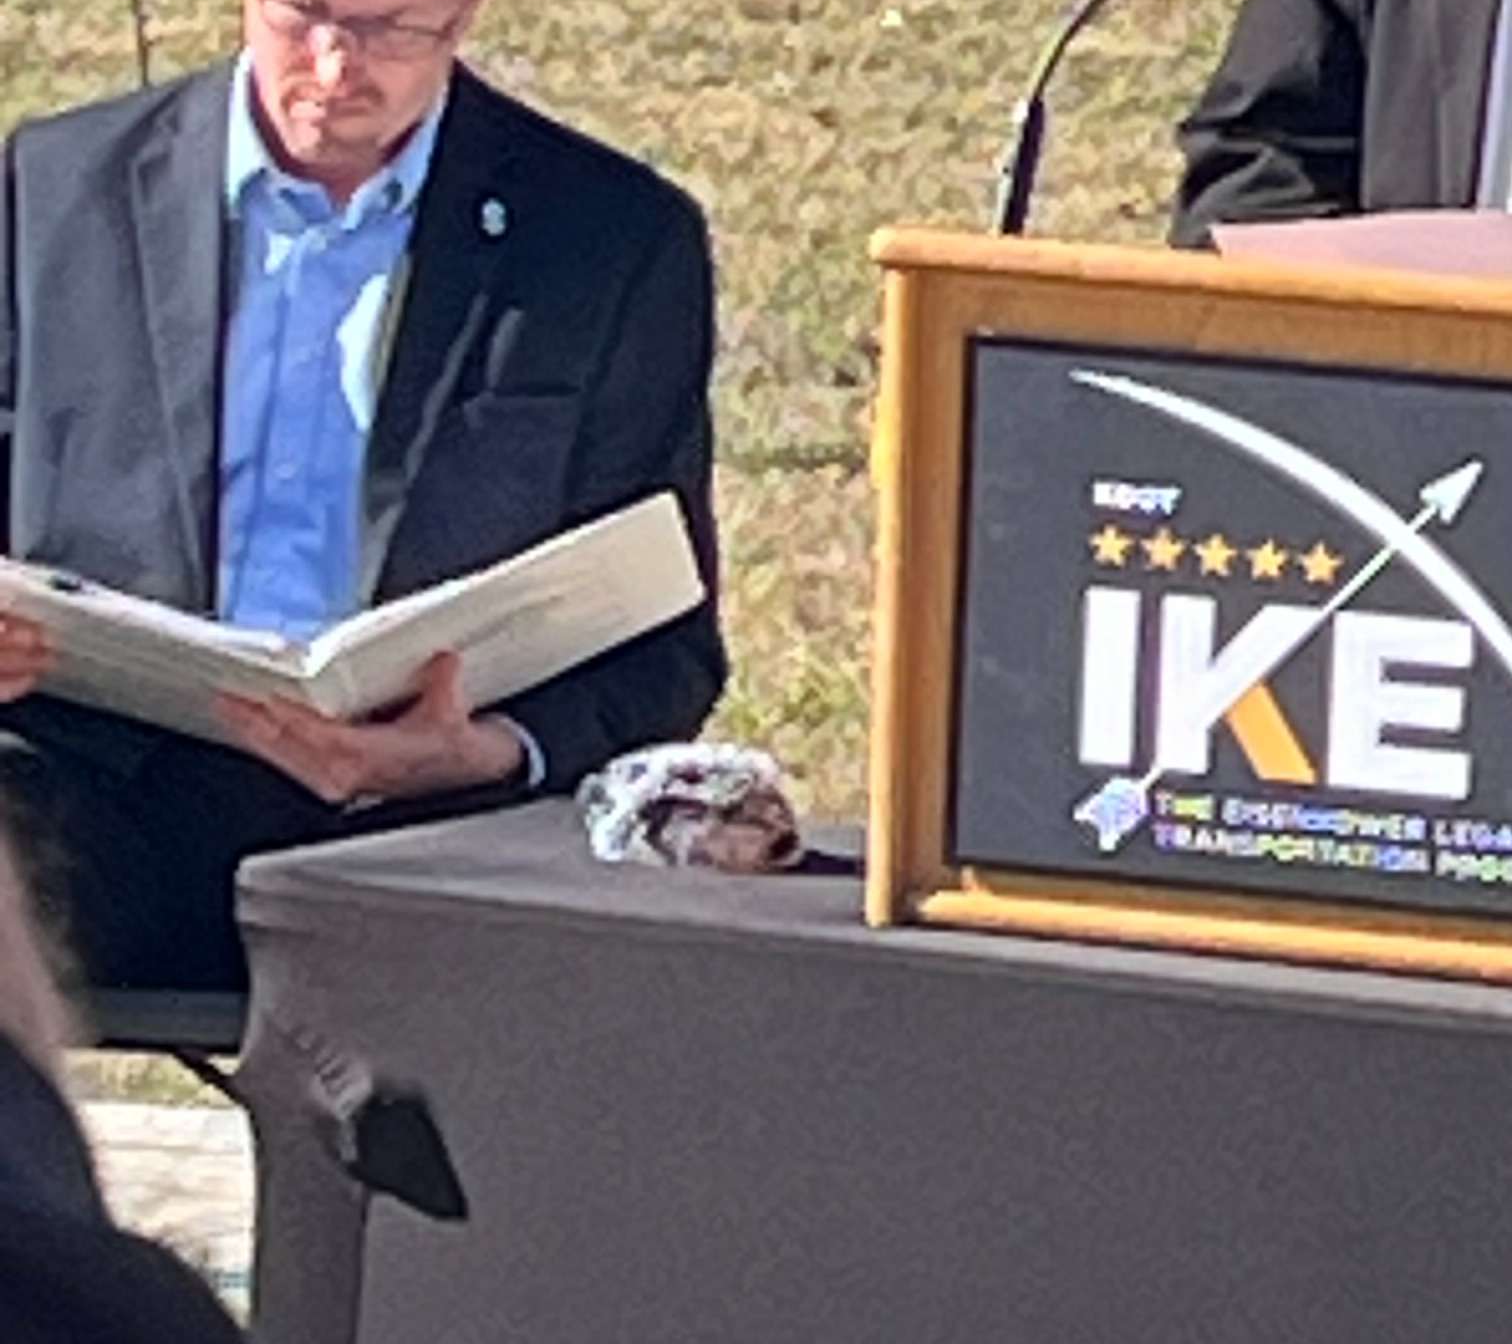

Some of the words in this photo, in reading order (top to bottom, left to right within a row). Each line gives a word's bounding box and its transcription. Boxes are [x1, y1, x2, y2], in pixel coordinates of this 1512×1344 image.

[1076, 586, 1476, 801] IKE
[1155, 790, 1214, 822] THE
[1154, 821, 1431, 874] TRANSPORTATION
